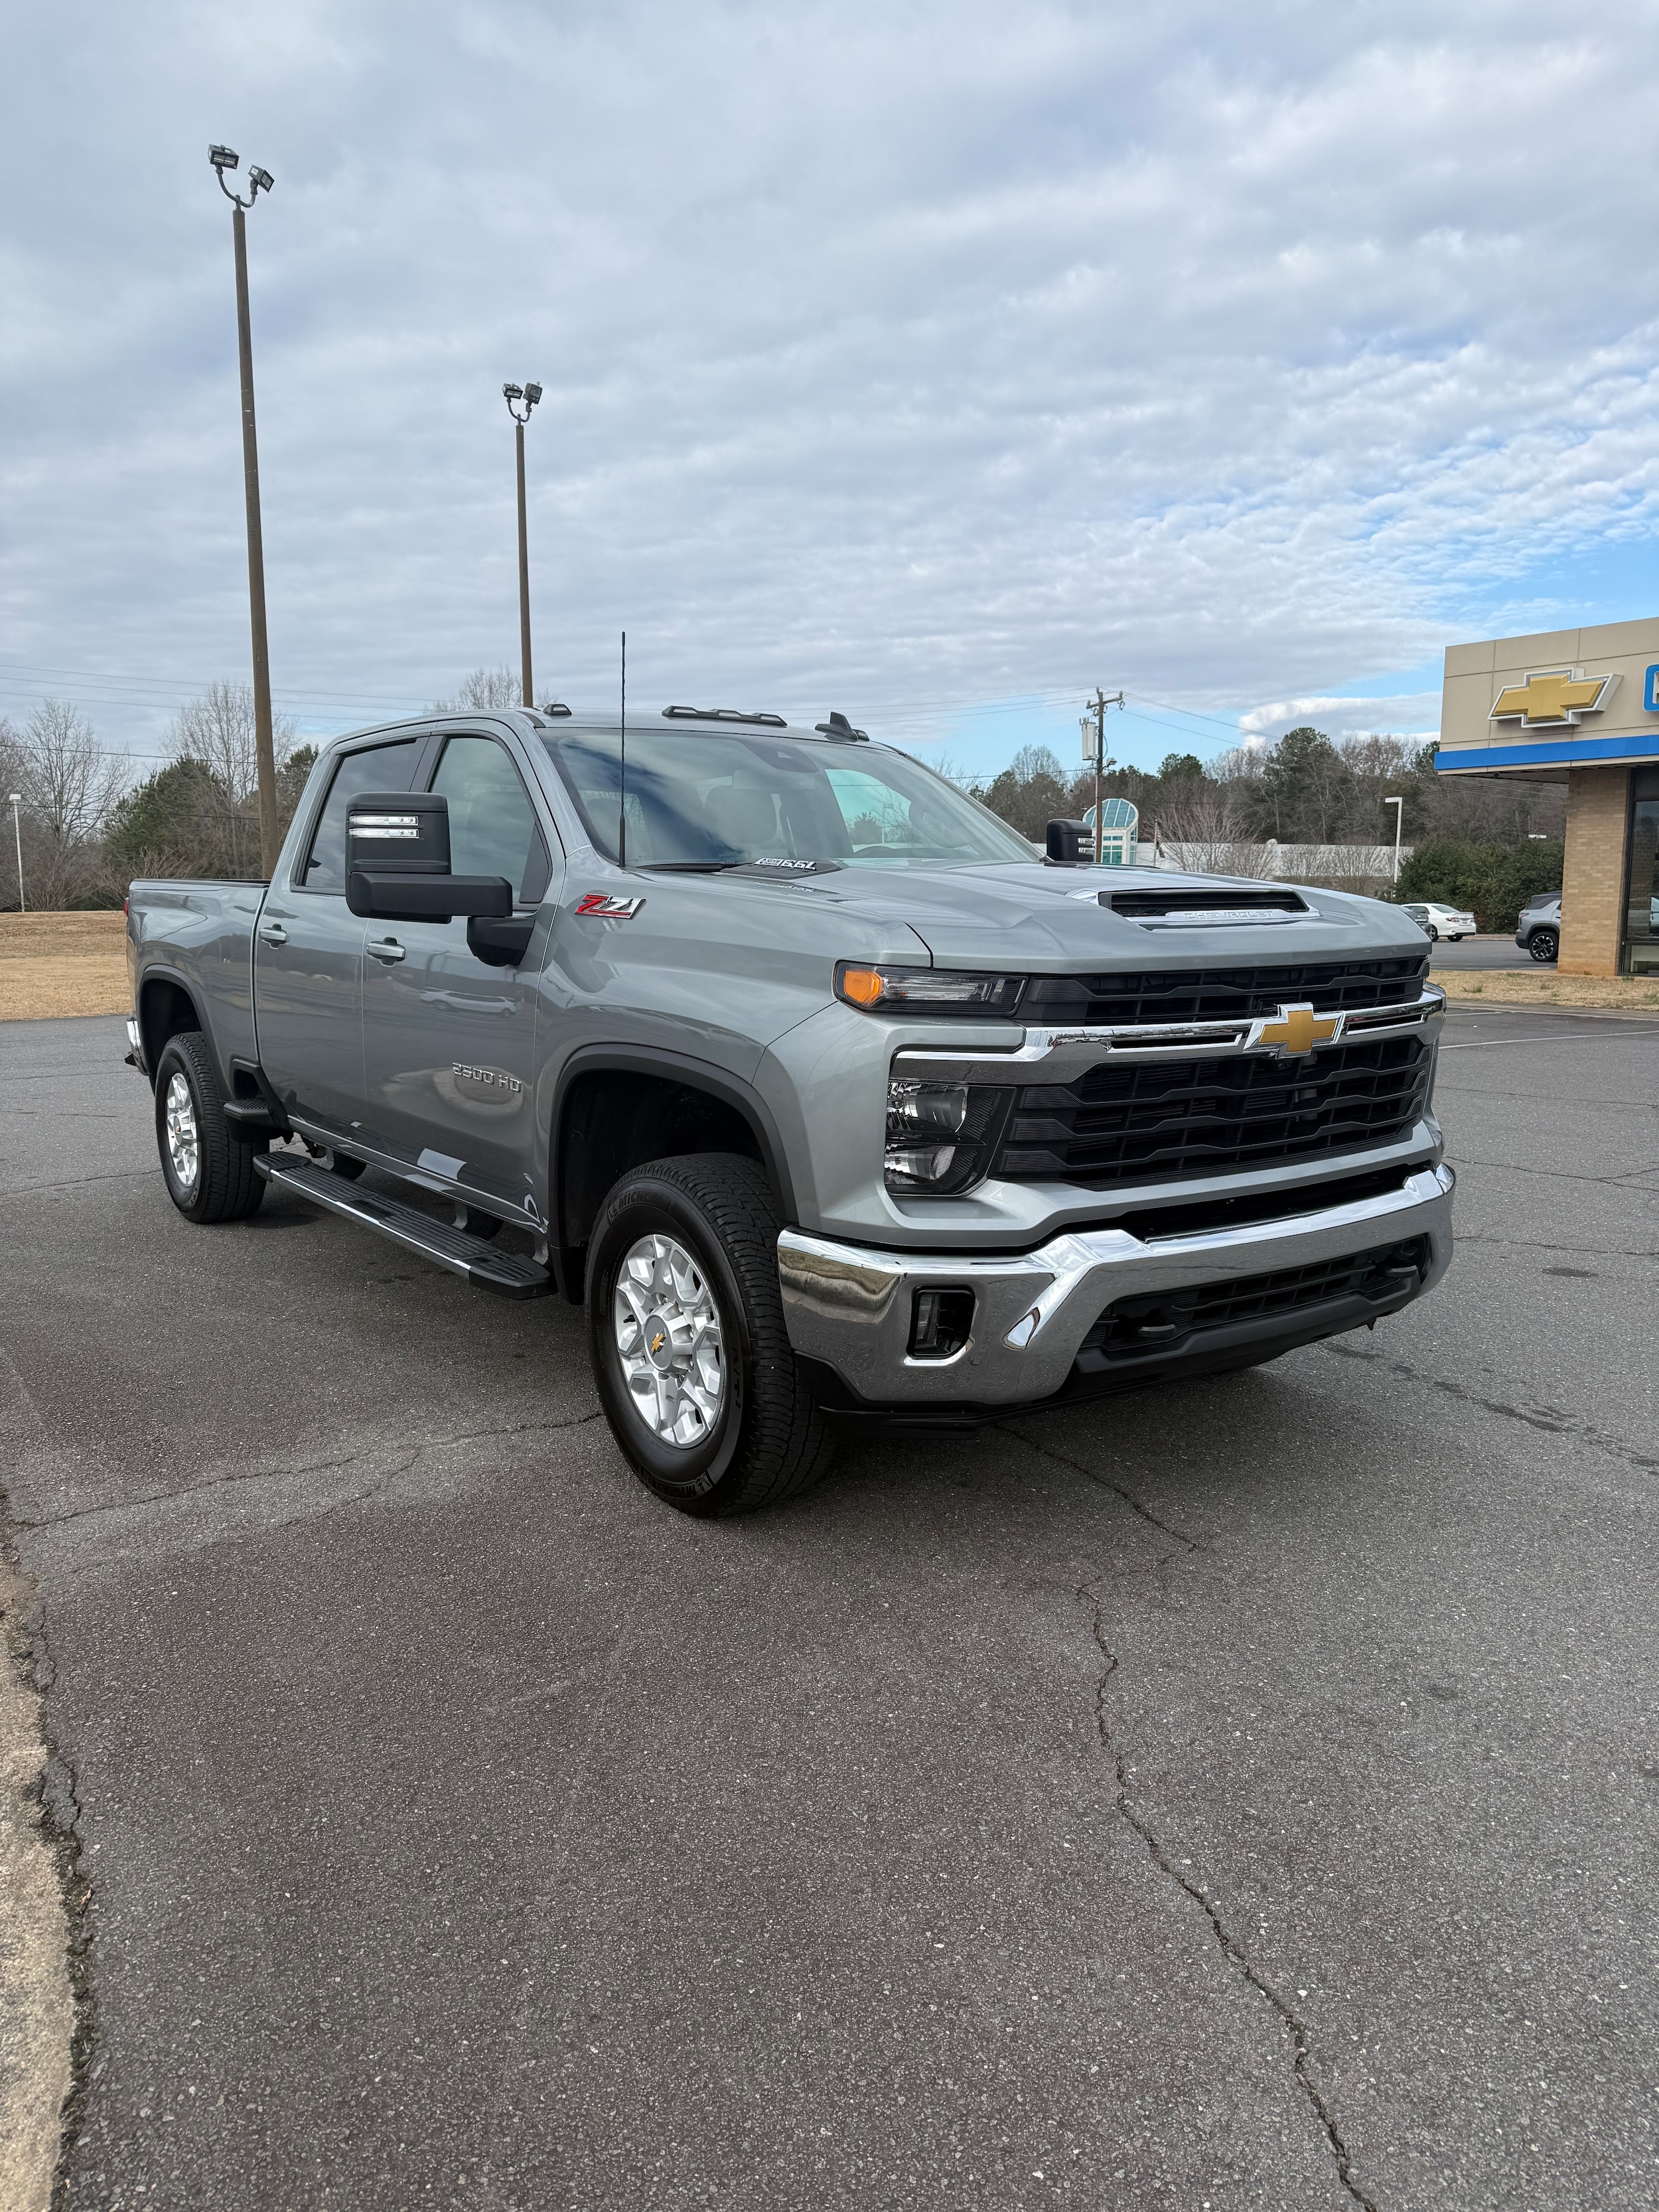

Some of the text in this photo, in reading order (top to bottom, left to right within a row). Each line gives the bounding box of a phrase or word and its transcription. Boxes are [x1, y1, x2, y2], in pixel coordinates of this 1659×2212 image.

[575, 893, 647, 921] Z71
[1184, 911, 1273, 919] CHEVROLET
[453, 1062, 522, 1092] 2500 HD
[618, 1189, 672, 1214] MICHIN
